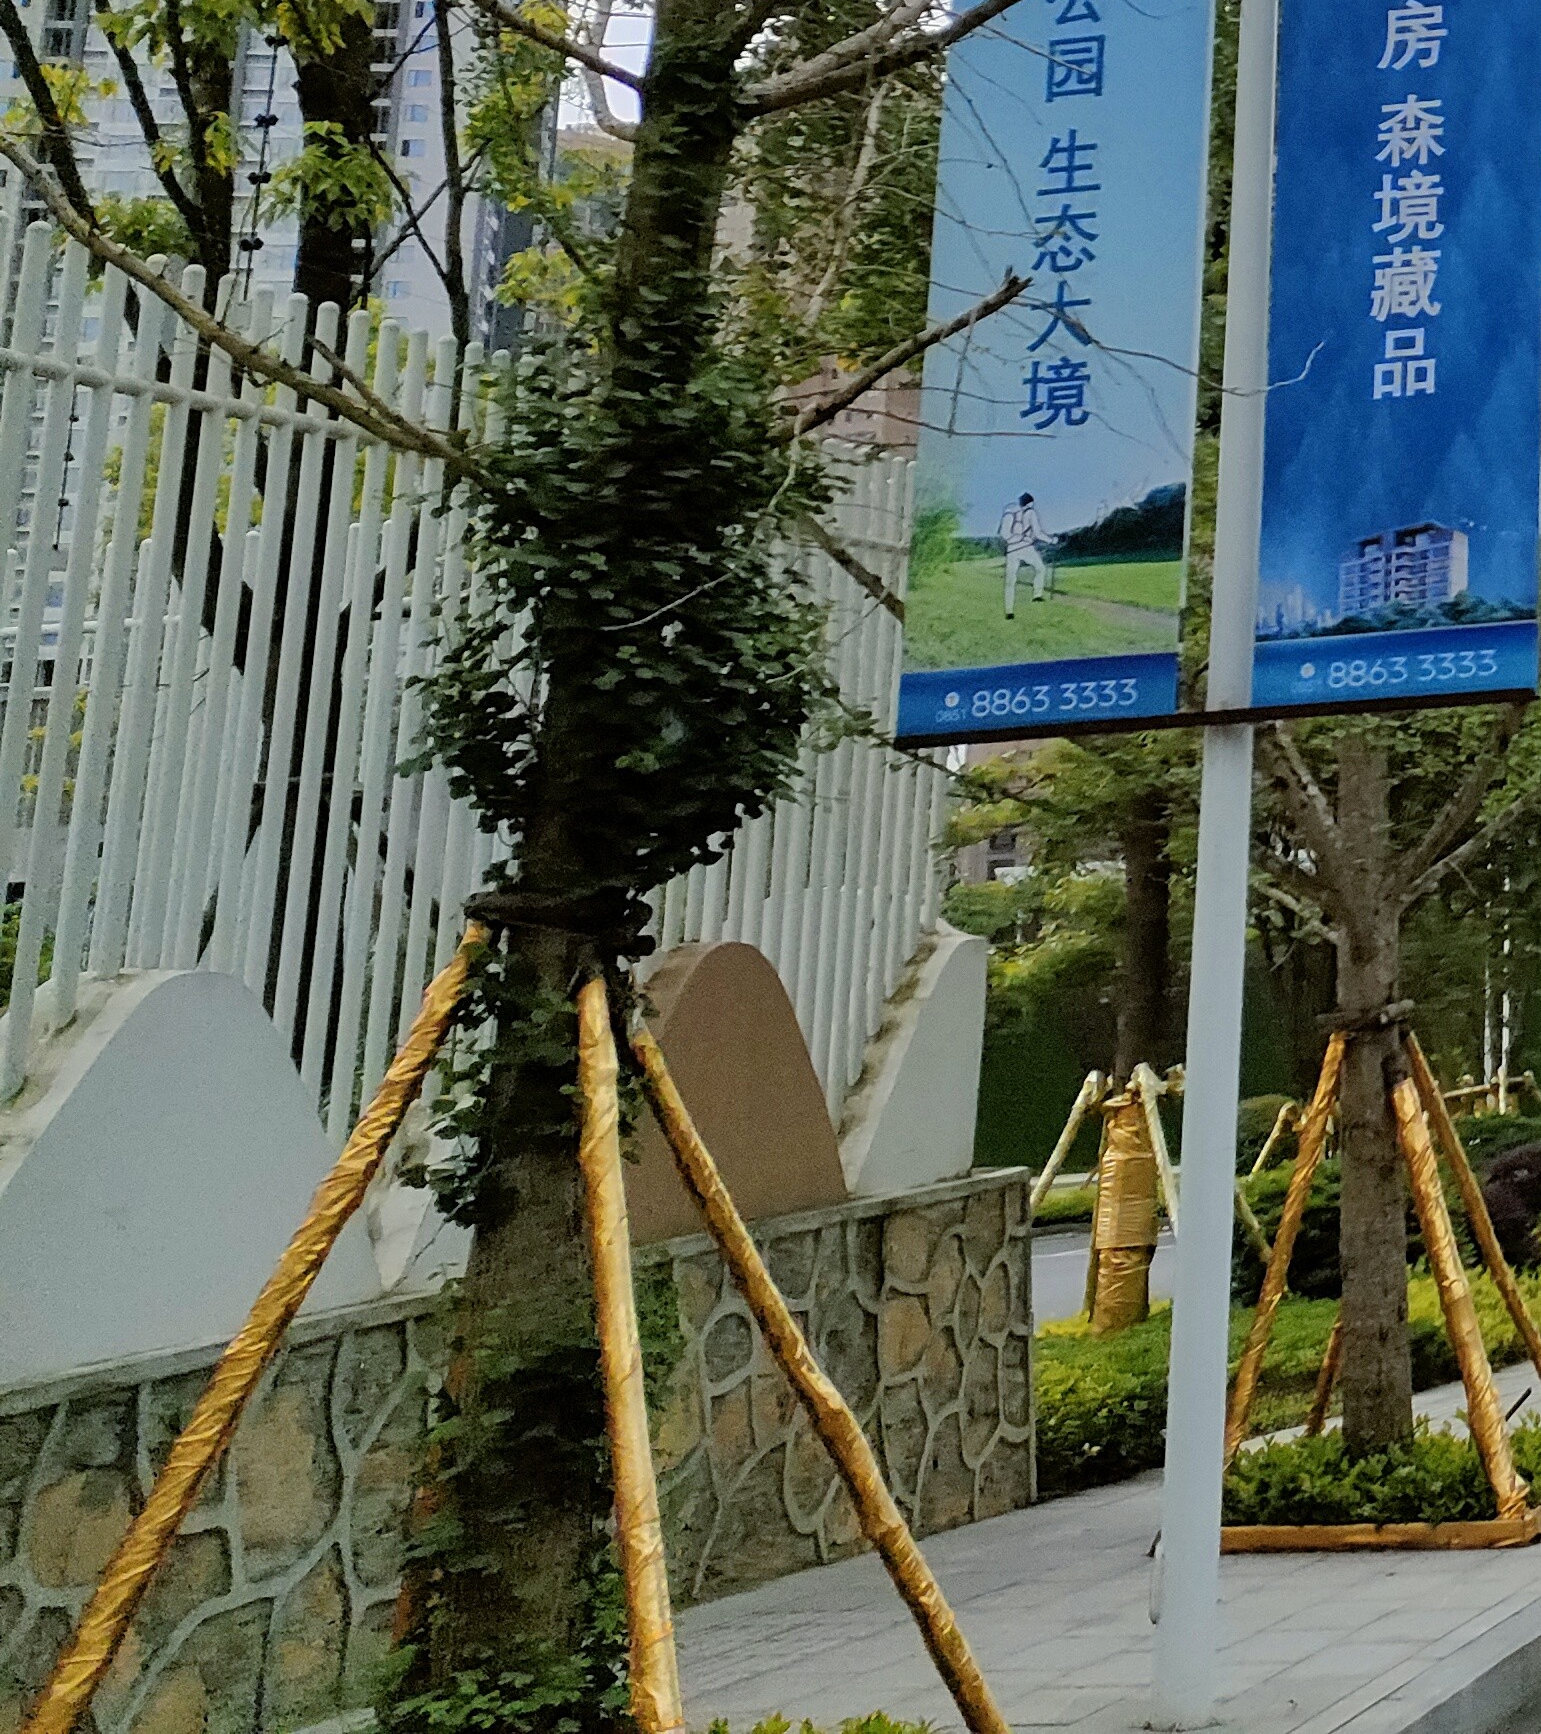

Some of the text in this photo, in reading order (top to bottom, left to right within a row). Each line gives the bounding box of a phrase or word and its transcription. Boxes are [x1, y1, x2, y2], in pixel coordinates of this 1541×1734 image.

[1019, 128, 1102, 430] 生态大境
[1369, 93, 1445, 399] 森境藏品
[971, 678, 1138, 717] 8863 3333
[1328, 656, 1408, 688] 8863
[1417, 649, 1498, 681] 3333
